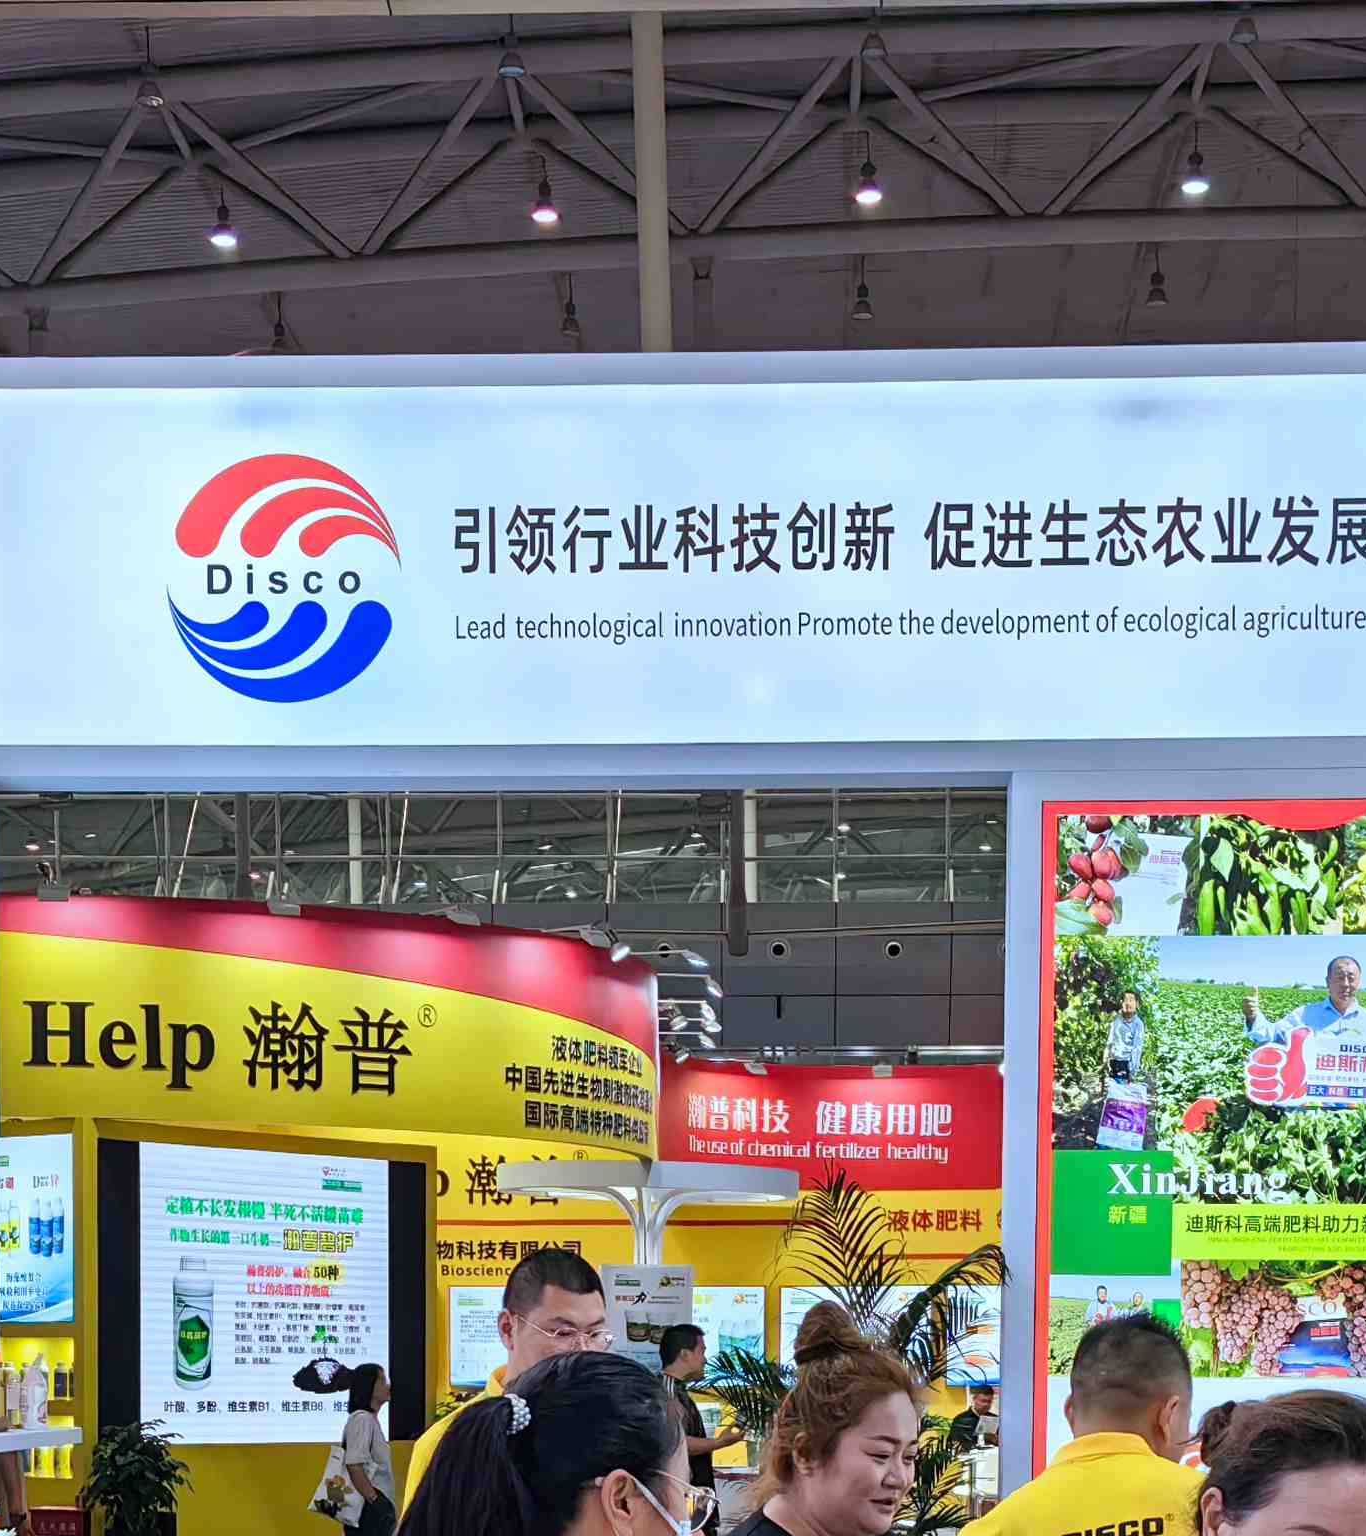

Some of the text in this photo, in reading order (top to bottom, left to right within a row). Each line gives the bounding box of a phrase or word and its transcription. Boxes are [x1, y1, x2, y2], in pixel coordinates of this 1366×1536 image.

[453, 502, 895, 576] 引领行业科技创新
[207, 564, 362, 596] Disco
[455, 614, 506, 640] Lead
[516, 611, 664, 645] technological
[674, 609, 792, 639] innovation
[799, 611, 893, 638] Promote
[899, 609, 935, 635] the
[940, 607, 1089, 641] development
[1095, 604, 1119, 633] of
[1123, 603, 1237, 640] ecological
[22, 1000, 413, 1096] Help 瀚普
[688, 1094, 952, 1137] 瀚普科技 健康用肥
[688, 1134, 949, 1164] The use of chemical fertilizer healthy
[1107, 1162, 1290, 1199] XinJiang
[885, 1208, 982, 1232] 液体肥料
[1108, 1205, 1148, 1225] 新疆
